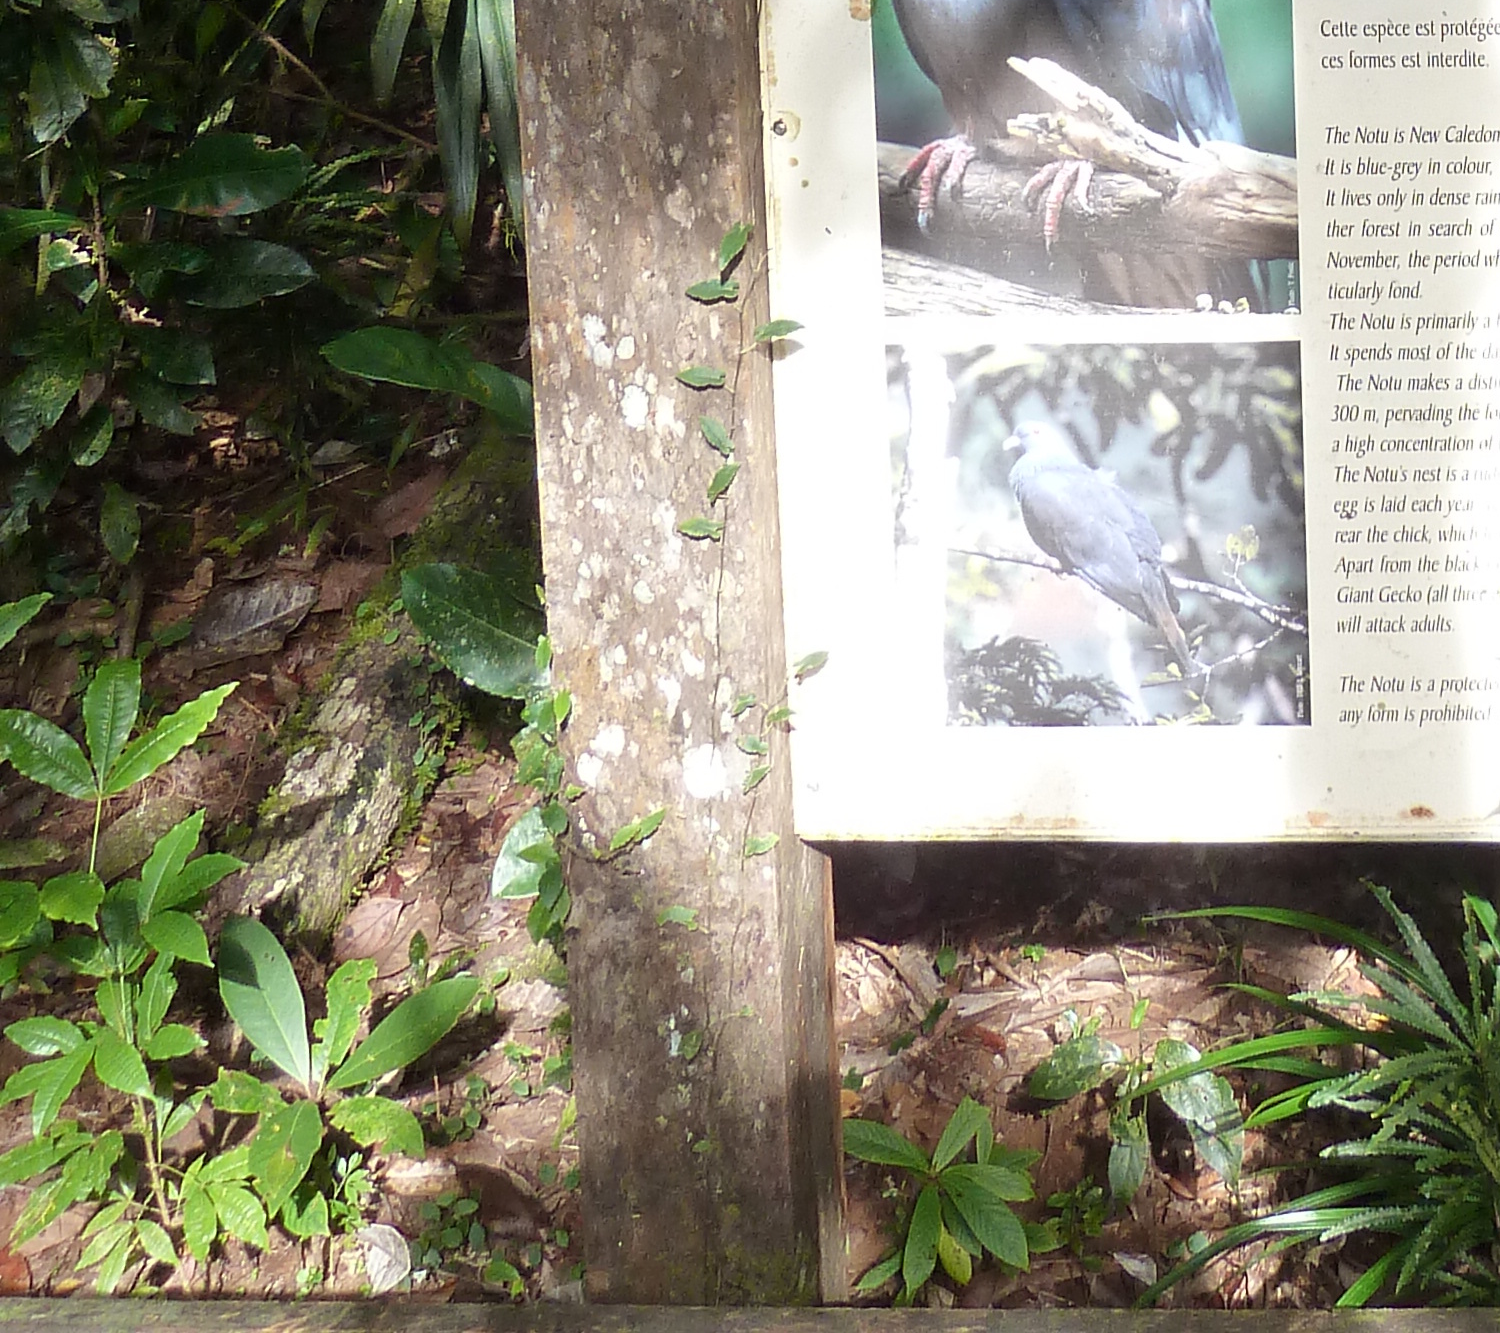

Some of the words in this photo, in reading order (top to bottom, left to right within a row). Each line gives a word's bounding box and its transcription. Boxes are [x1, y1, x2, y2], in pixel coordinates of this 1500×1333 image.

[1320, 19, 1358, 37] Cette
[1362, 19, 1411, 43] espèce
[1415, 20, 1436, 36] est
[1321, 55, 1344, 68] ces
[1349, 49, 1396, 68] formes
[1401, 52, 1421, 68] est
[1427, 49, 1489, 68] interdite.
[1326, 125, 1351, 144] The
[1354, 126, 1390, 144] Notu
[1393, 128, 1406, 144] is
[1408, 126, 1442, 144] New
[1324, 157, 1336, 175] It
[1339, 159, 1353, 175] is
[1356, 156, 1423, 182] blue-grey
[1427, 157, 1442, 174] in
[1445, 155, 1492, 174] colour,
[1325, 189, 1337, 206] It
[1340, 187, 1372, 206] lives
[1375, 188, 1408, 212] only
[1410, 188, 1425, 206] in
[1428, 187, 1471, 205] dense
[1325, 218, 1355, 237] ther
[1360, 219, 1401, 238] forest
[1407, 220, 1422, 237] in
[1428, 218, 1473, 237] search
[1479, 220, 1495, 236] of
[1326, 249, 1401, 269] November,
[1407, 249, 1431, 268] the
[1432, 250, 1482, 274] period
[1327, 281, 1384, 306] ticularly
[1387, 281, 1422, 299] fond.
[1330, 312, 1356, 330] The
[1359, 313, 1396, 330] Notu
[1399, 313, 1413, 330] is
[1414, 311, 1476, 335] primarily
[1329, 344, 1340, 360] It
[1343, 343, 1393, 367] spends
[1397, 344, 1432, 361] most
[1435, 342, 1453, 360] of
[1454, 343, 1475, 360] the
[1331, 440, 1341, 452] a
[1344, 434, 1376, 458] high
[1379, 436, 1475, 452] concentration
[1336, 615, 1362, 633] will
[1365, 615, 1406, 633] attack
[1409, 615, 1453, 632] adults.
[1341, 675, 1366, 692] The
[1369, 676, 1406, 692] Notu
[1409, 676, 1423, 691] is
[1426, 680, 1436, 691] a
[1338, 709, 1364, 727] any
[1366, 703, 1400, 722] form
[1403, 707, 1416, 722] is
